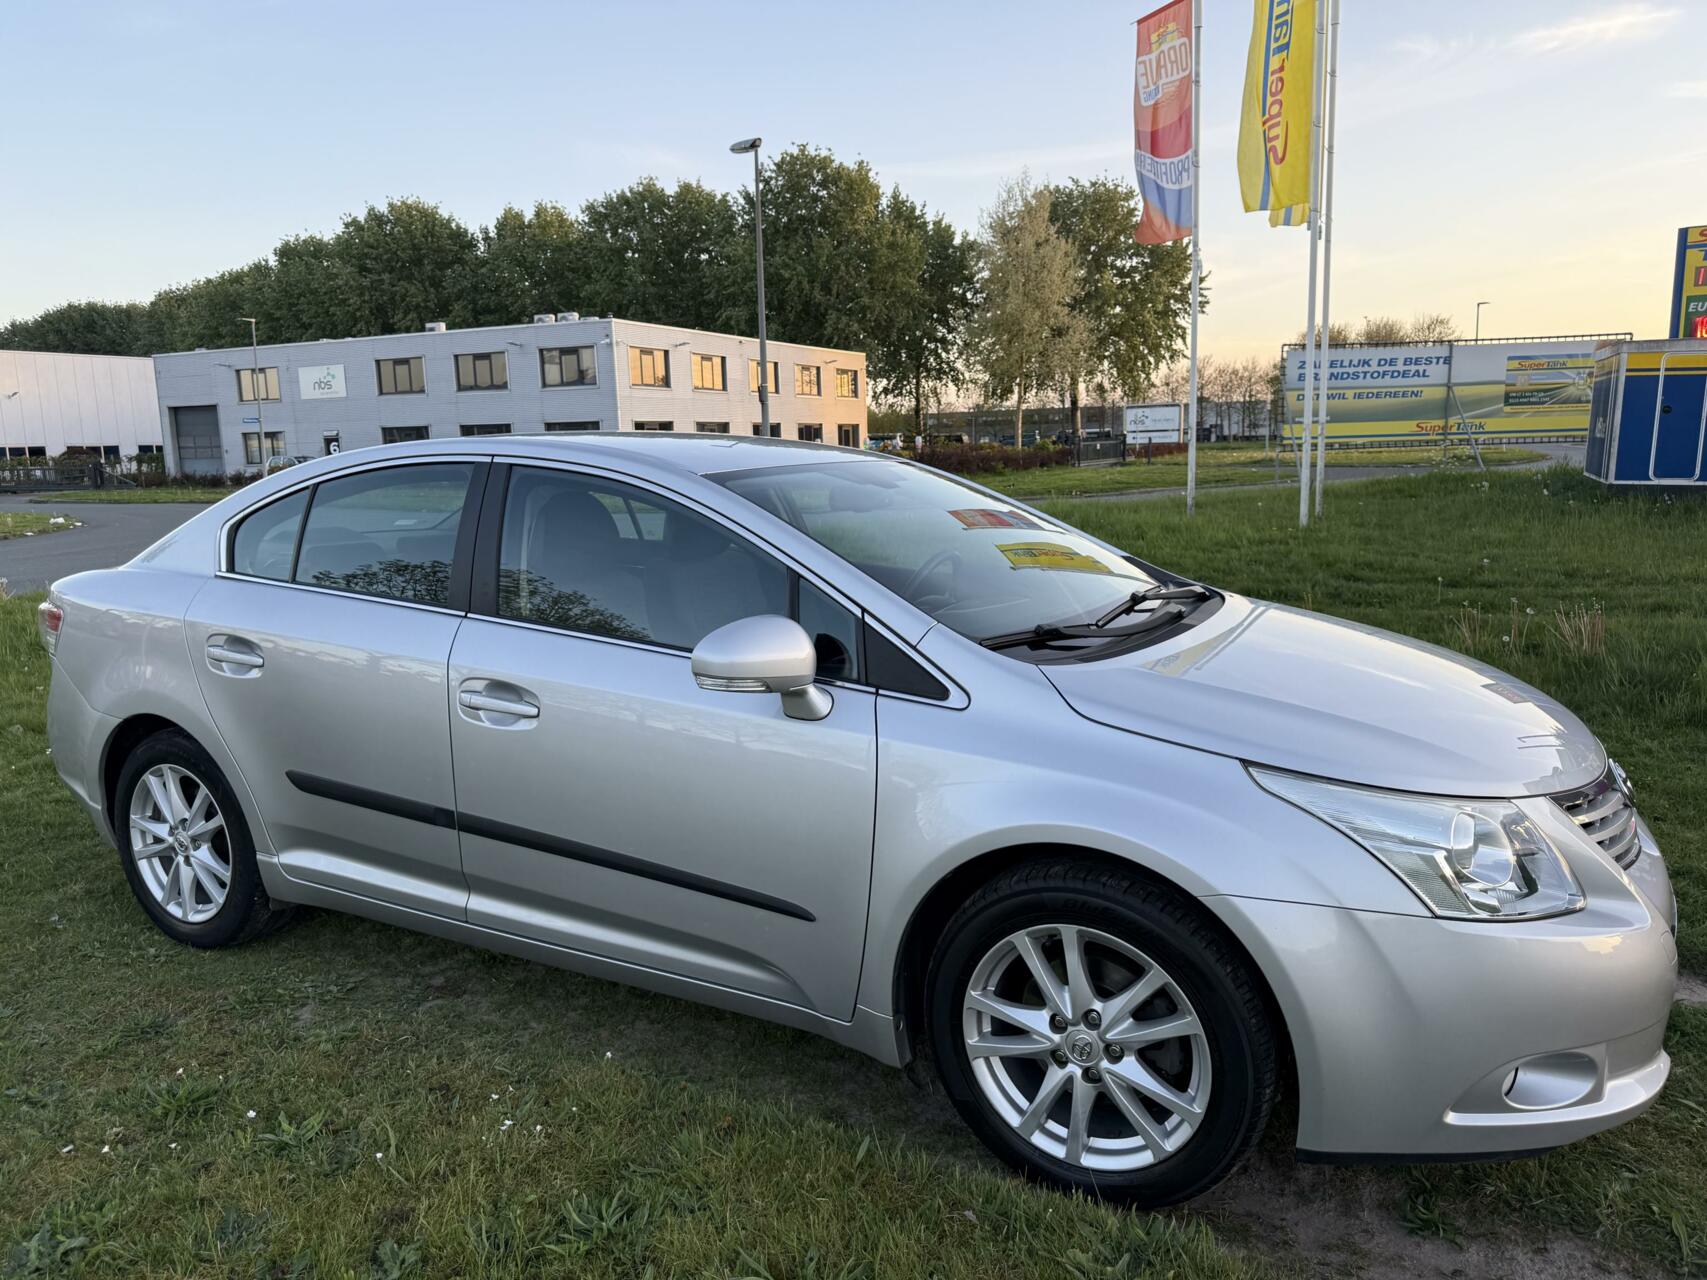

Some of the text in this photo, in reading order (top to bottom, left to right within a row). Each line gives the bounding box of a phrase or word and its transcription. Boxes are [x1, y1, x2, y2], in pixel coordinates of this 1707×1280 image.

[1297, 355, 1451, 370] ZELIJK DE BESTE
[1297, 369, 1429, 382] BRNDSTOFDEAL
[1327, 392, 1348, 400] WIL
[1353, 390, 1424, 400] IEDEREEN!
[330, 441, 340, 454] 6
